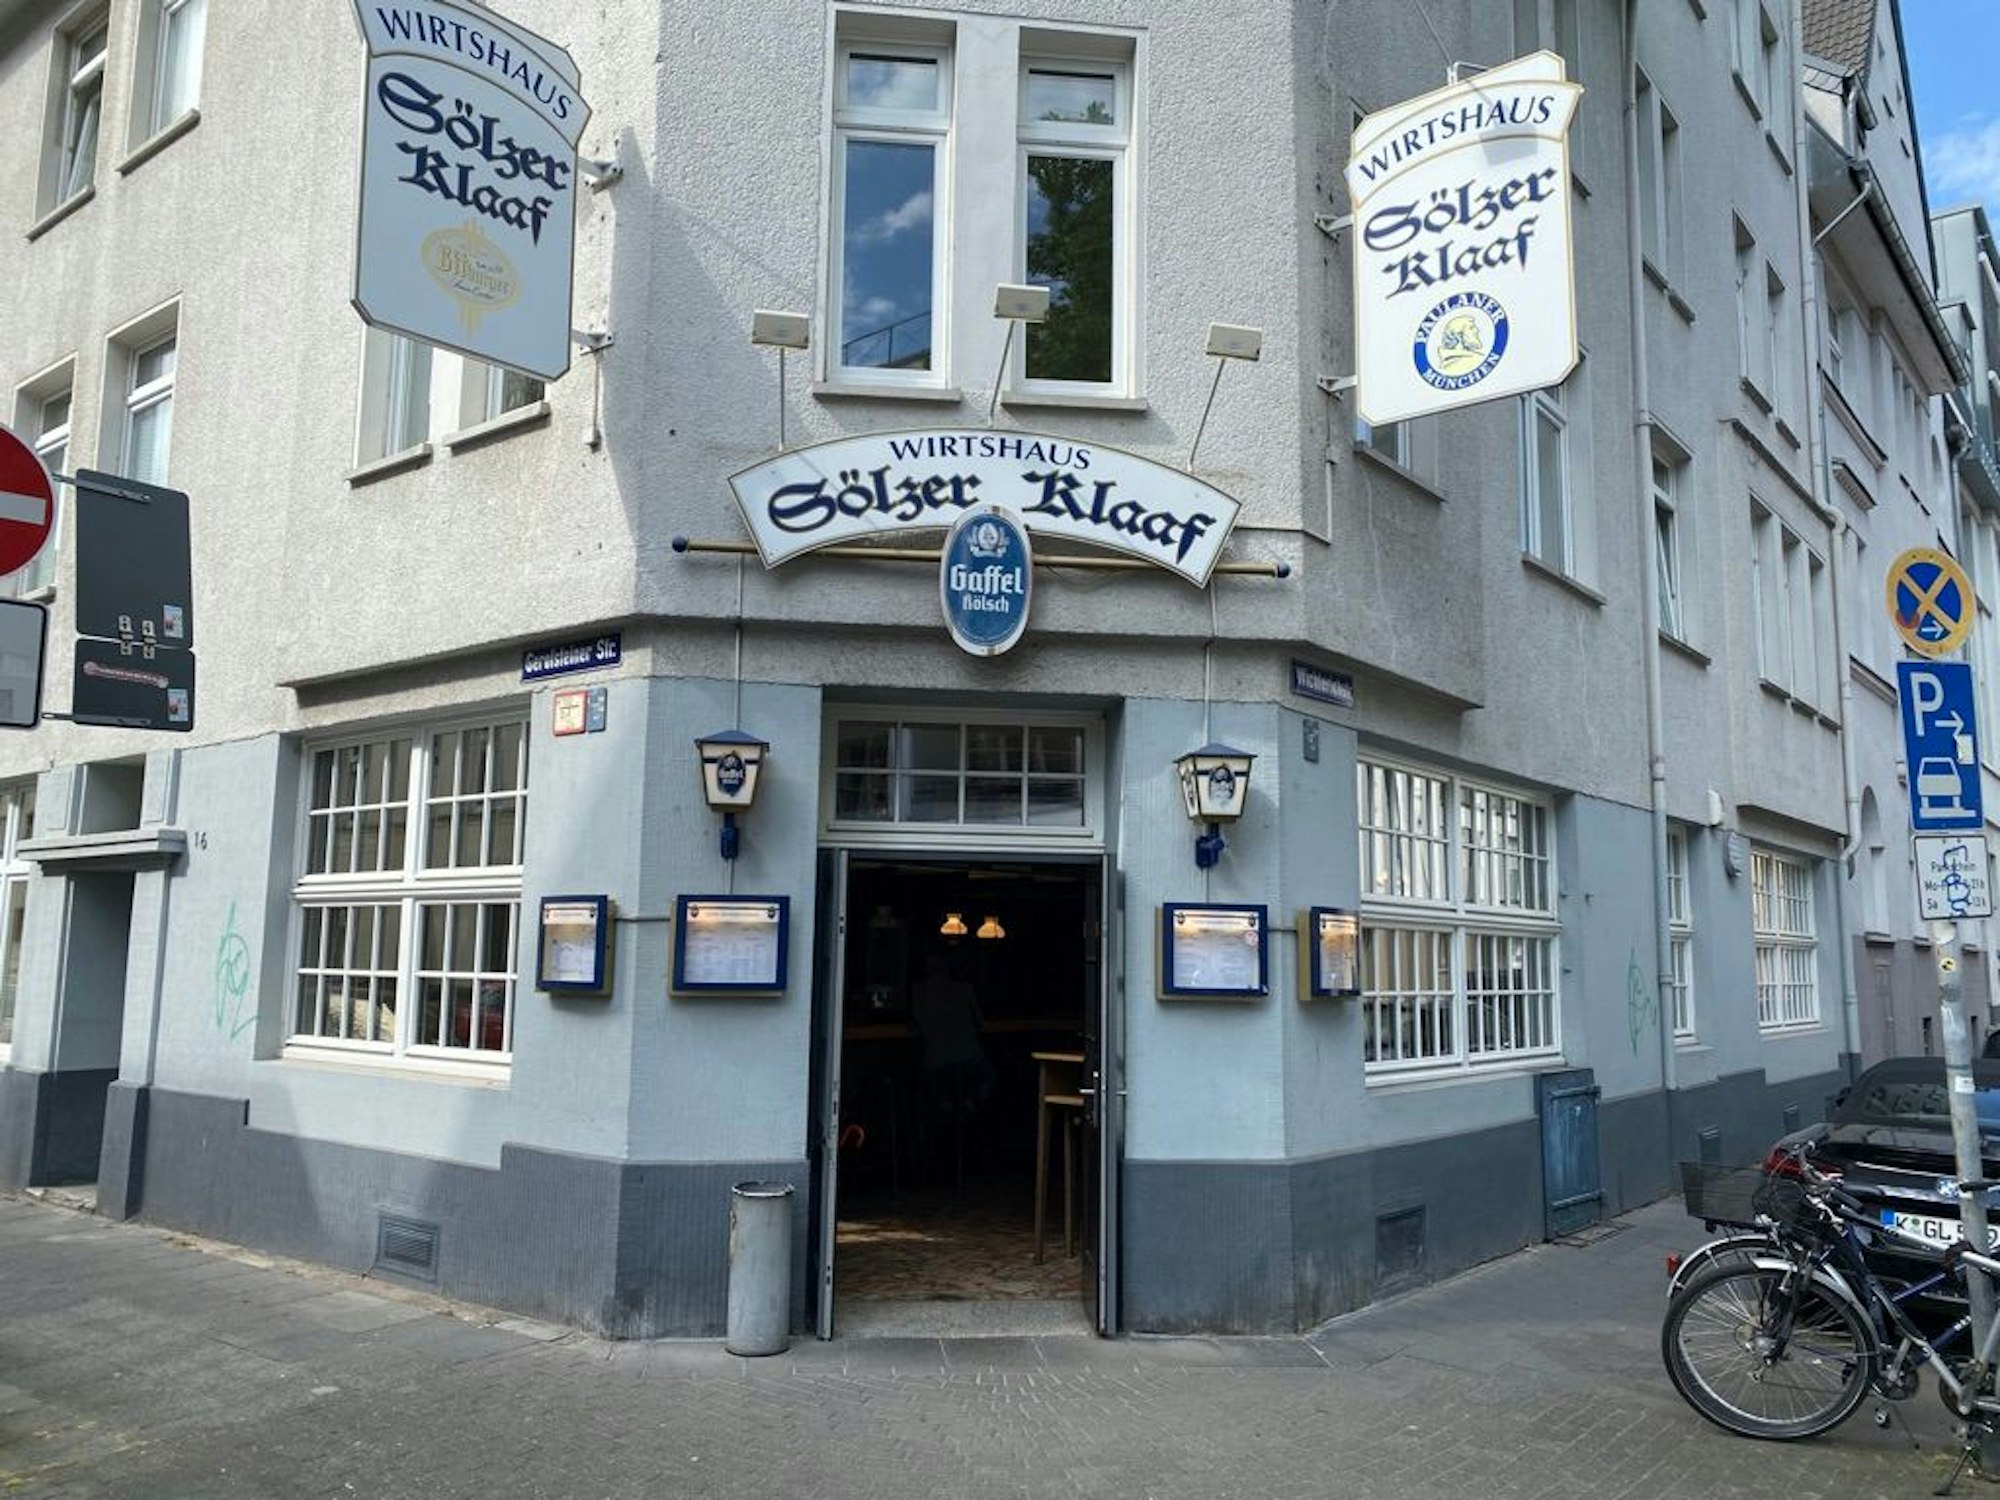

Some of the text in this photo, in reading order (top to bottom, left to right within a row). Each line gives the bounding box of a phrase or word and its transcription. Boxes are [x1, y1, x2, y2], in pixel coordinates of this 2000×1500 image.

[377, 8, 572, 120] WIRTSHAUS
[377, 72, 571, 191] Sölzer
[1359, 96, 1555, 182] WIRTSHAUS
[396, 140, 553, 248] Klaaf
[1364, 167, 1557, 252] Sölzer
[1381, 215, 1539, 301] Klaaf
[1414, 292, 1505, 344] PAULANER
[890, 435, 1090, 469] WIRTSHAUS
[767, 465, 1217, 565] Sölzer Klaaf
[949, 564, 1024, 595] Gaffel
[962, 593, 1010, 613] Kölsch
[1909, 671, 1945, 737] P
[194, 831, 208, 850] 16
